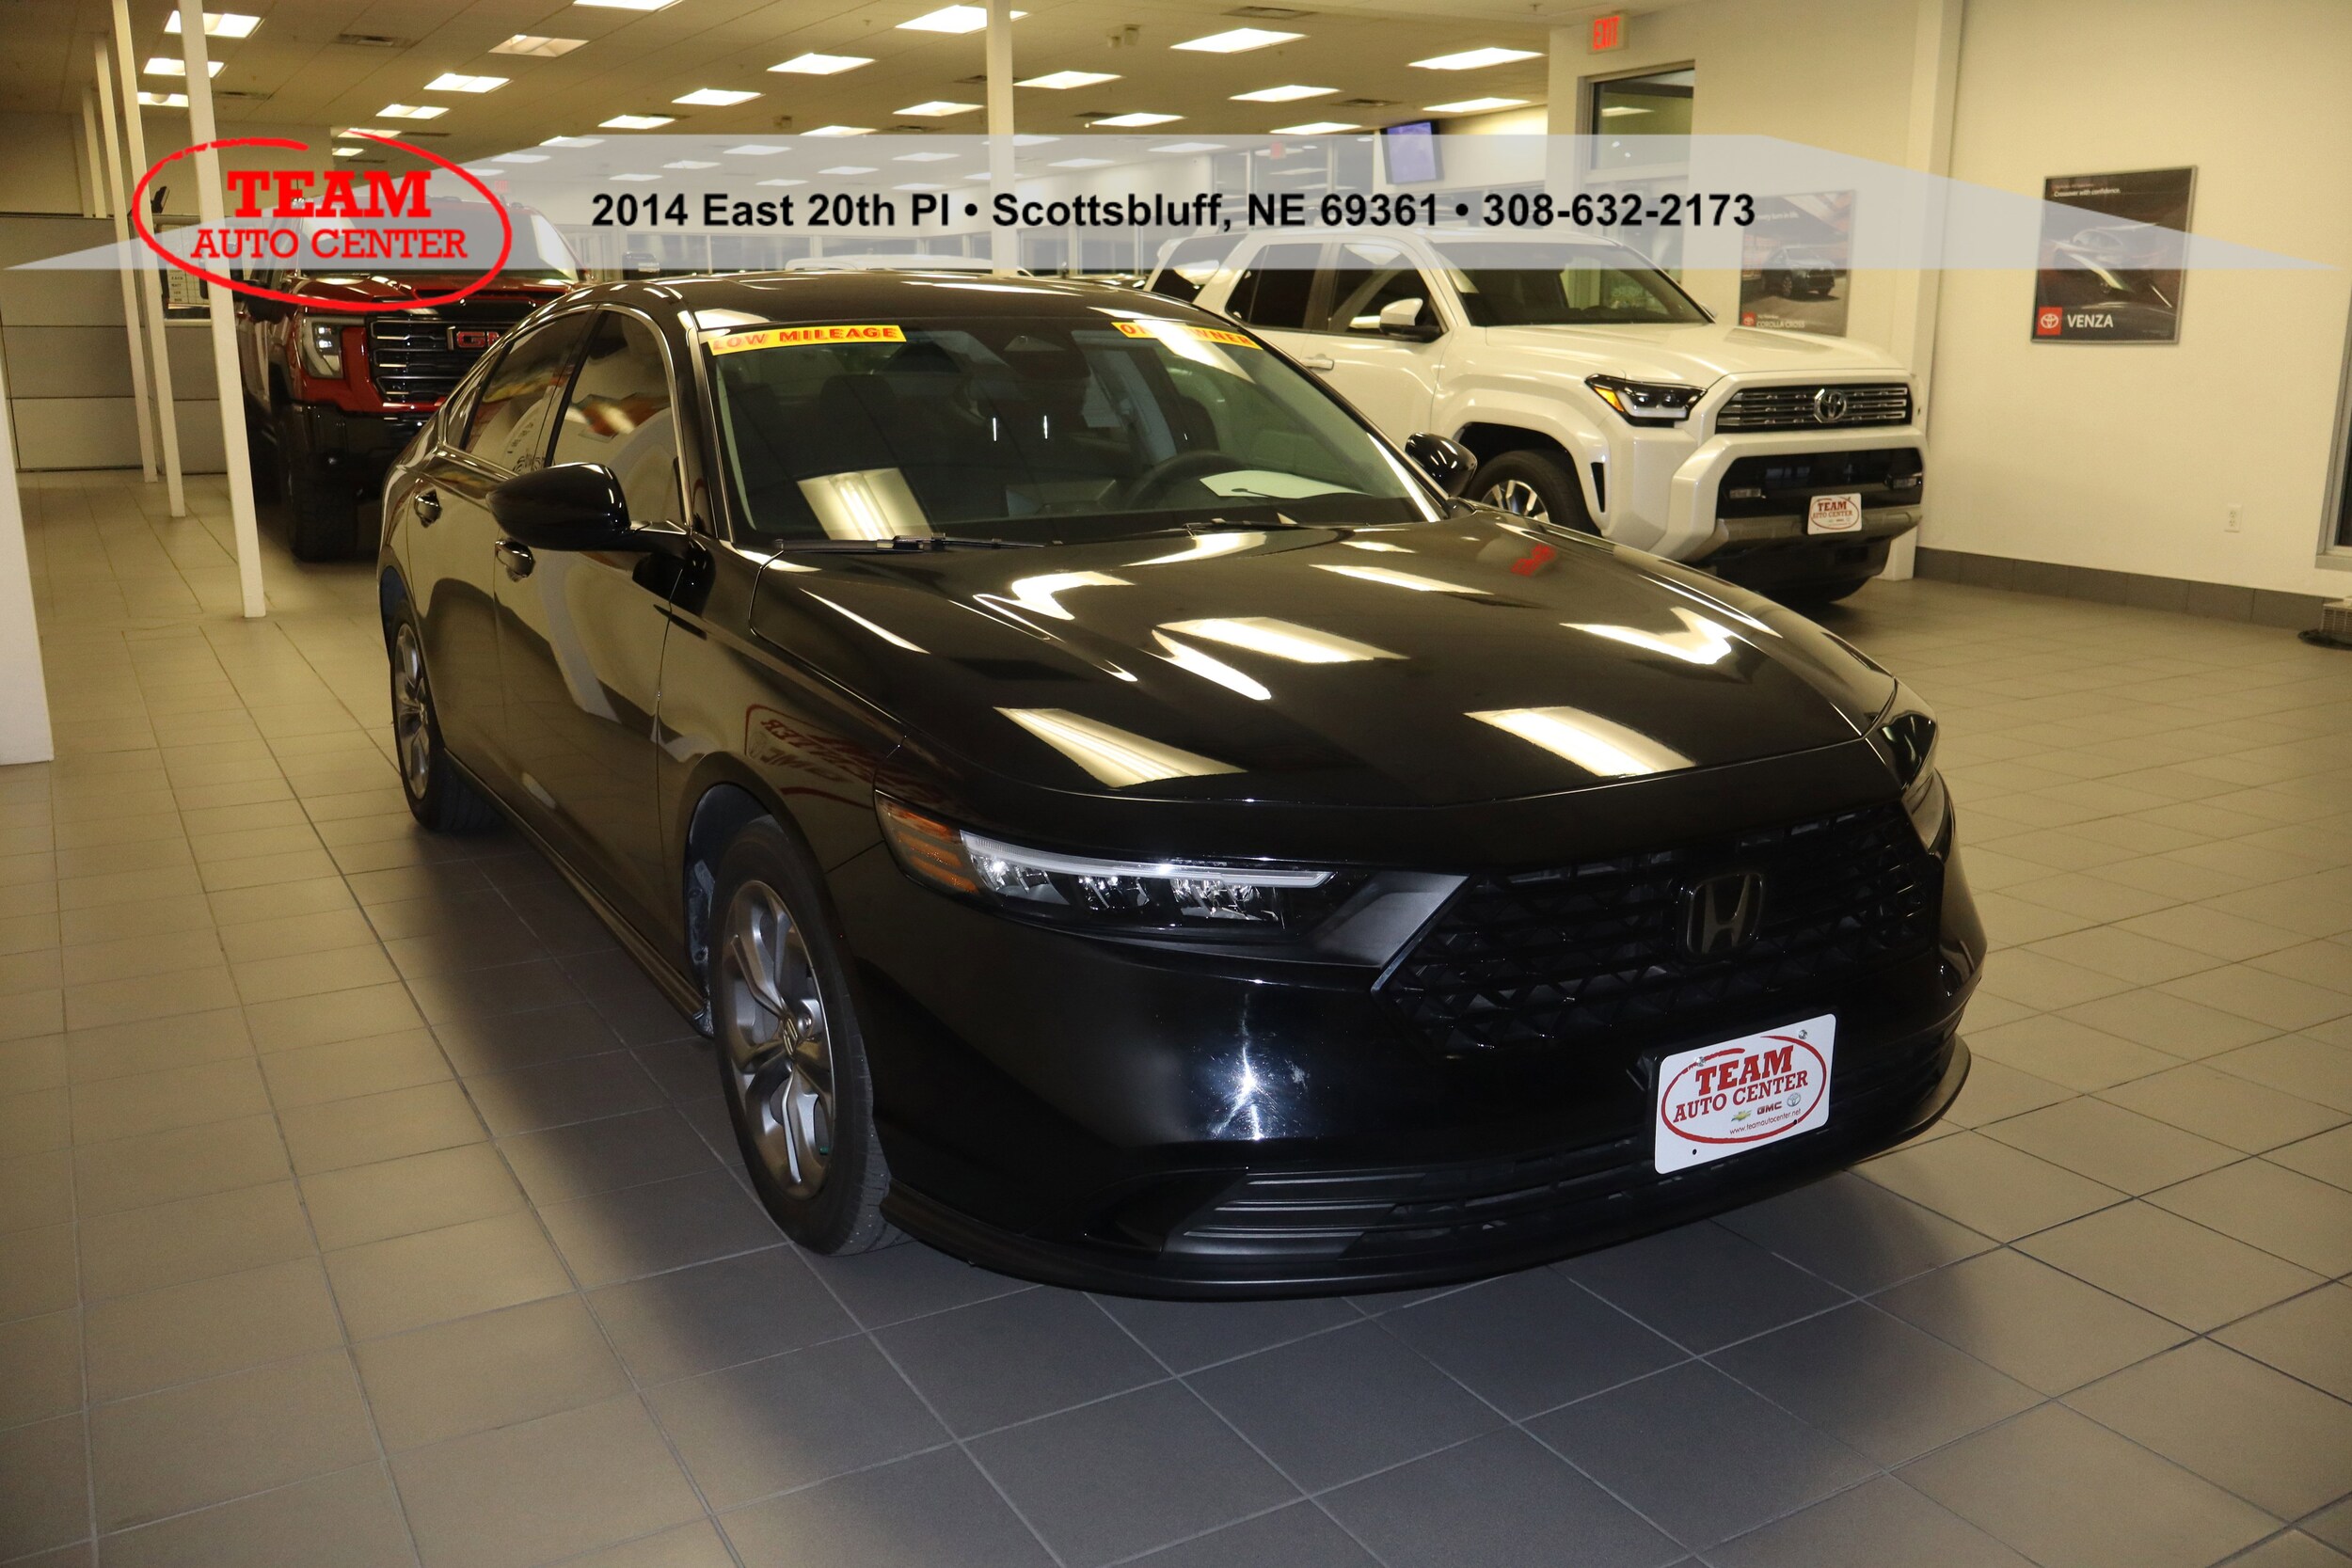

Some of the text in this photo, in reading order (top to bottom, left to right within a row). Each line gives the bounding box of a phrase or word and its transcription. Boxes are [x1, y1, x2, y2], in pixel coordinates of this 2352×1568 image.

[1593, 15, 1620, 51] EXIT
[1756, 319, 1805, 329] COROLLA CROSS
[2067, 313, 2114, 328] VENZA
[712, 326, 899, 351] LOW MILEAGE
[1183, 326, 1255, 346] WNER
[1818, 500, 1847, 512] TEAM
[1828, 510, 1853, 518] CENTER
[1694, 1045, 1794, 1097] TEAM
[1673, 1069, 1809, 1123] AUTO CENTER
[1756, 1101, 1783, 1116] GMC
[1729, 1108, 1802, 1135] www.teamautocenter.net
